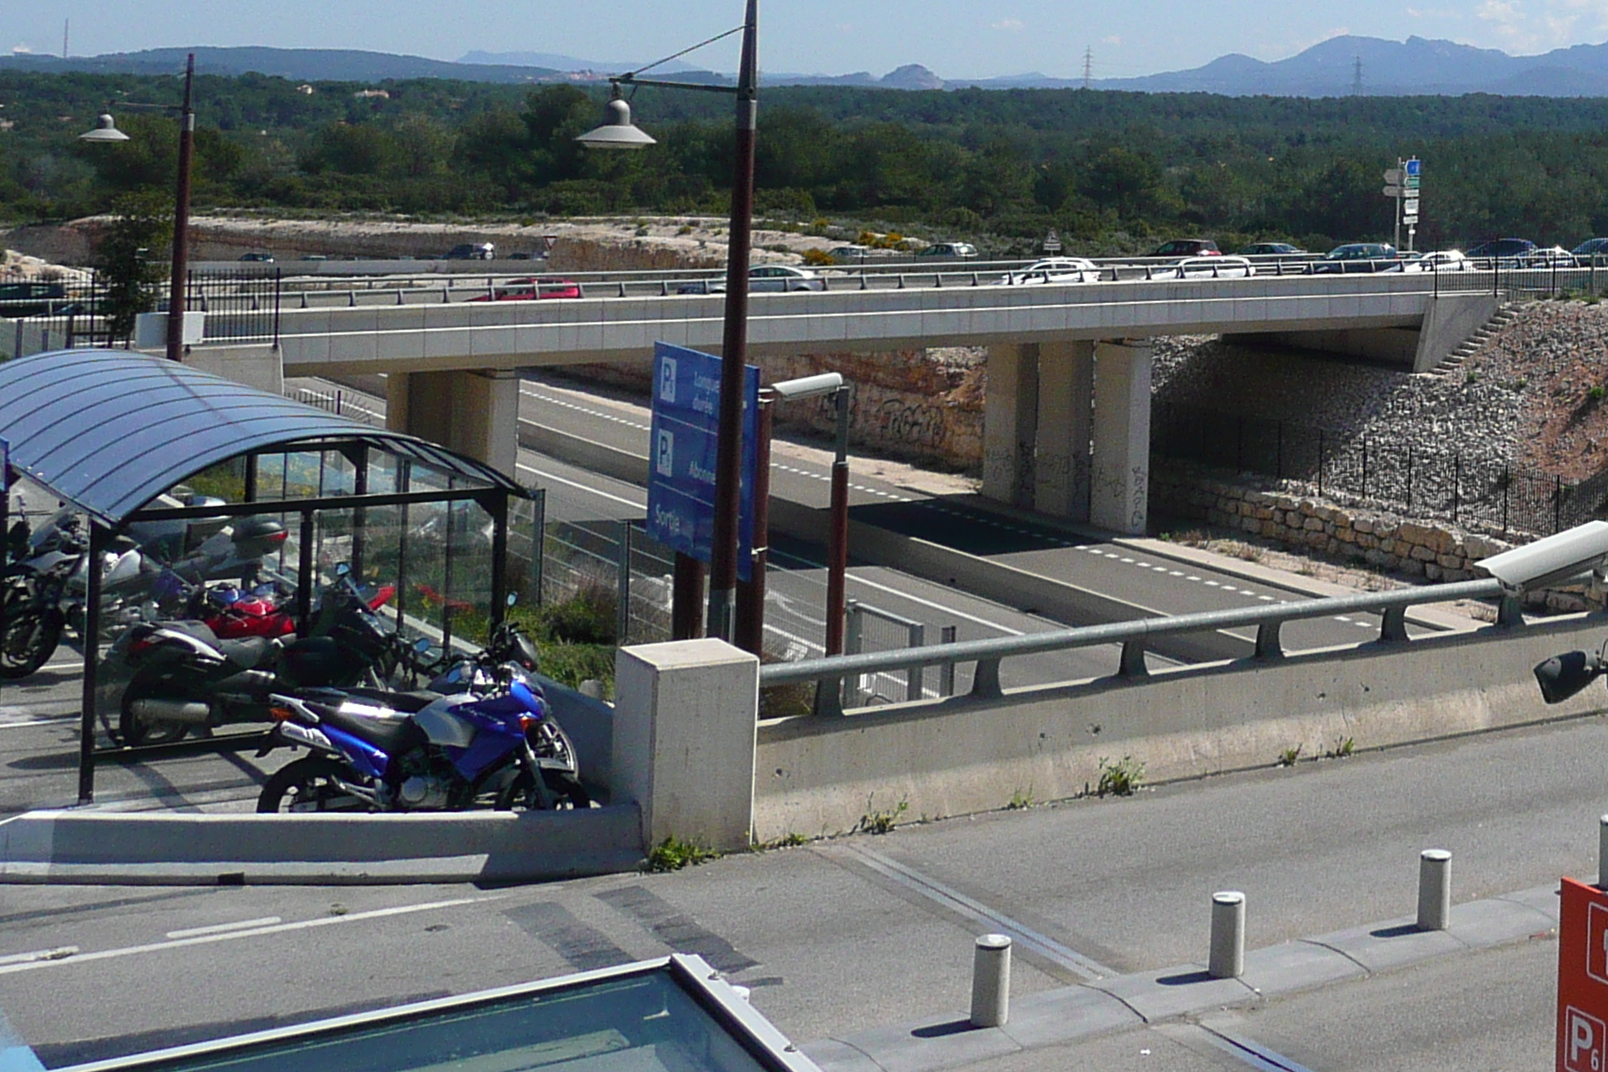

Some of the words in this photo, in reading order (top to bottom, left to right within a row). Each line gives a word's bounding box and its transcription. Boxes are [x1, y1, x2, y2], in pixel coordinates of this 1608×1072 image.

[694, 370, 720, 395] Longue
[692, 394, 713, 415] durée
[655, 503, 680, 533] Sortie
[1571, 1014, 1599, 1071] P6
